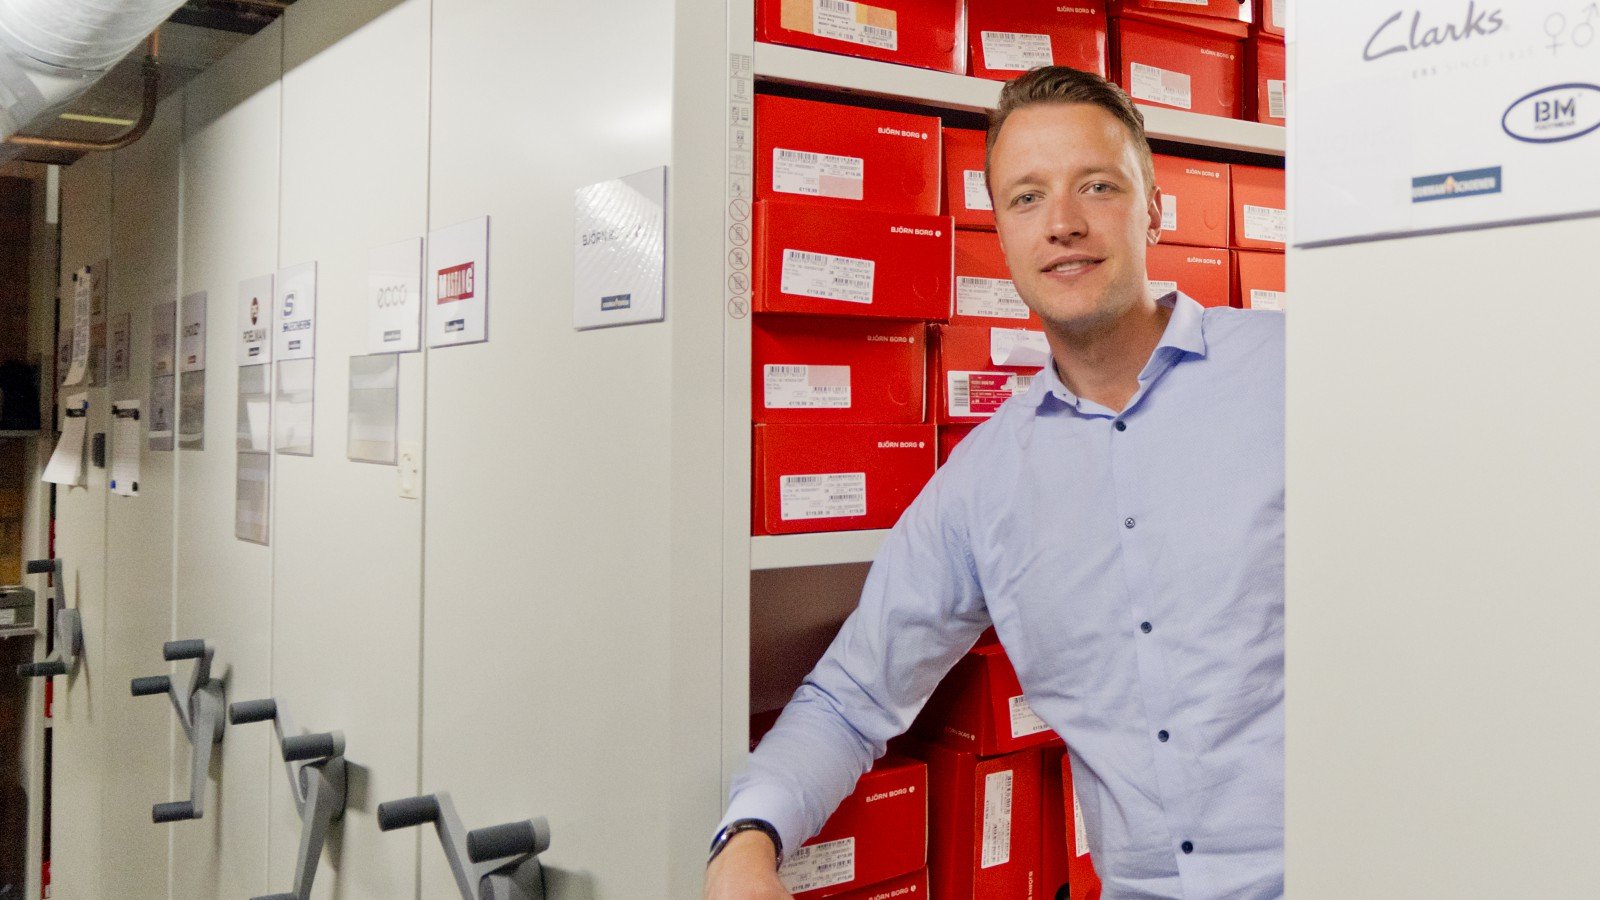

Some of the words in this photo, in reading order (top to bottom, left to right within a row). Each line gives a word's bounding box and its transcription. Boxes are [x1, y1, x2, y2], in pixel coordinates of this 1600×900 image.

[1362, 0, 1504, 61] Clarks
[1535, 97, 1575, 123] BM
[877, 127, 900, 136] BJÖRN
[901, 130, 920, 139] BORG
[1186, 167, 1202, 177] BJÖRN
[1202, 169, 1215, 178] BORG
[890, 225, 914, 235] BJÖRN
[914, 228, 934, 237] BORG
[889, 336, 908, 344] BORG
[877, 440, 899, 448] BJÖRN
[865, 791, 888, 803] BJÖRN
[888, 787, 907, 798] BORG
[890, 887, 909, 898] BORG
